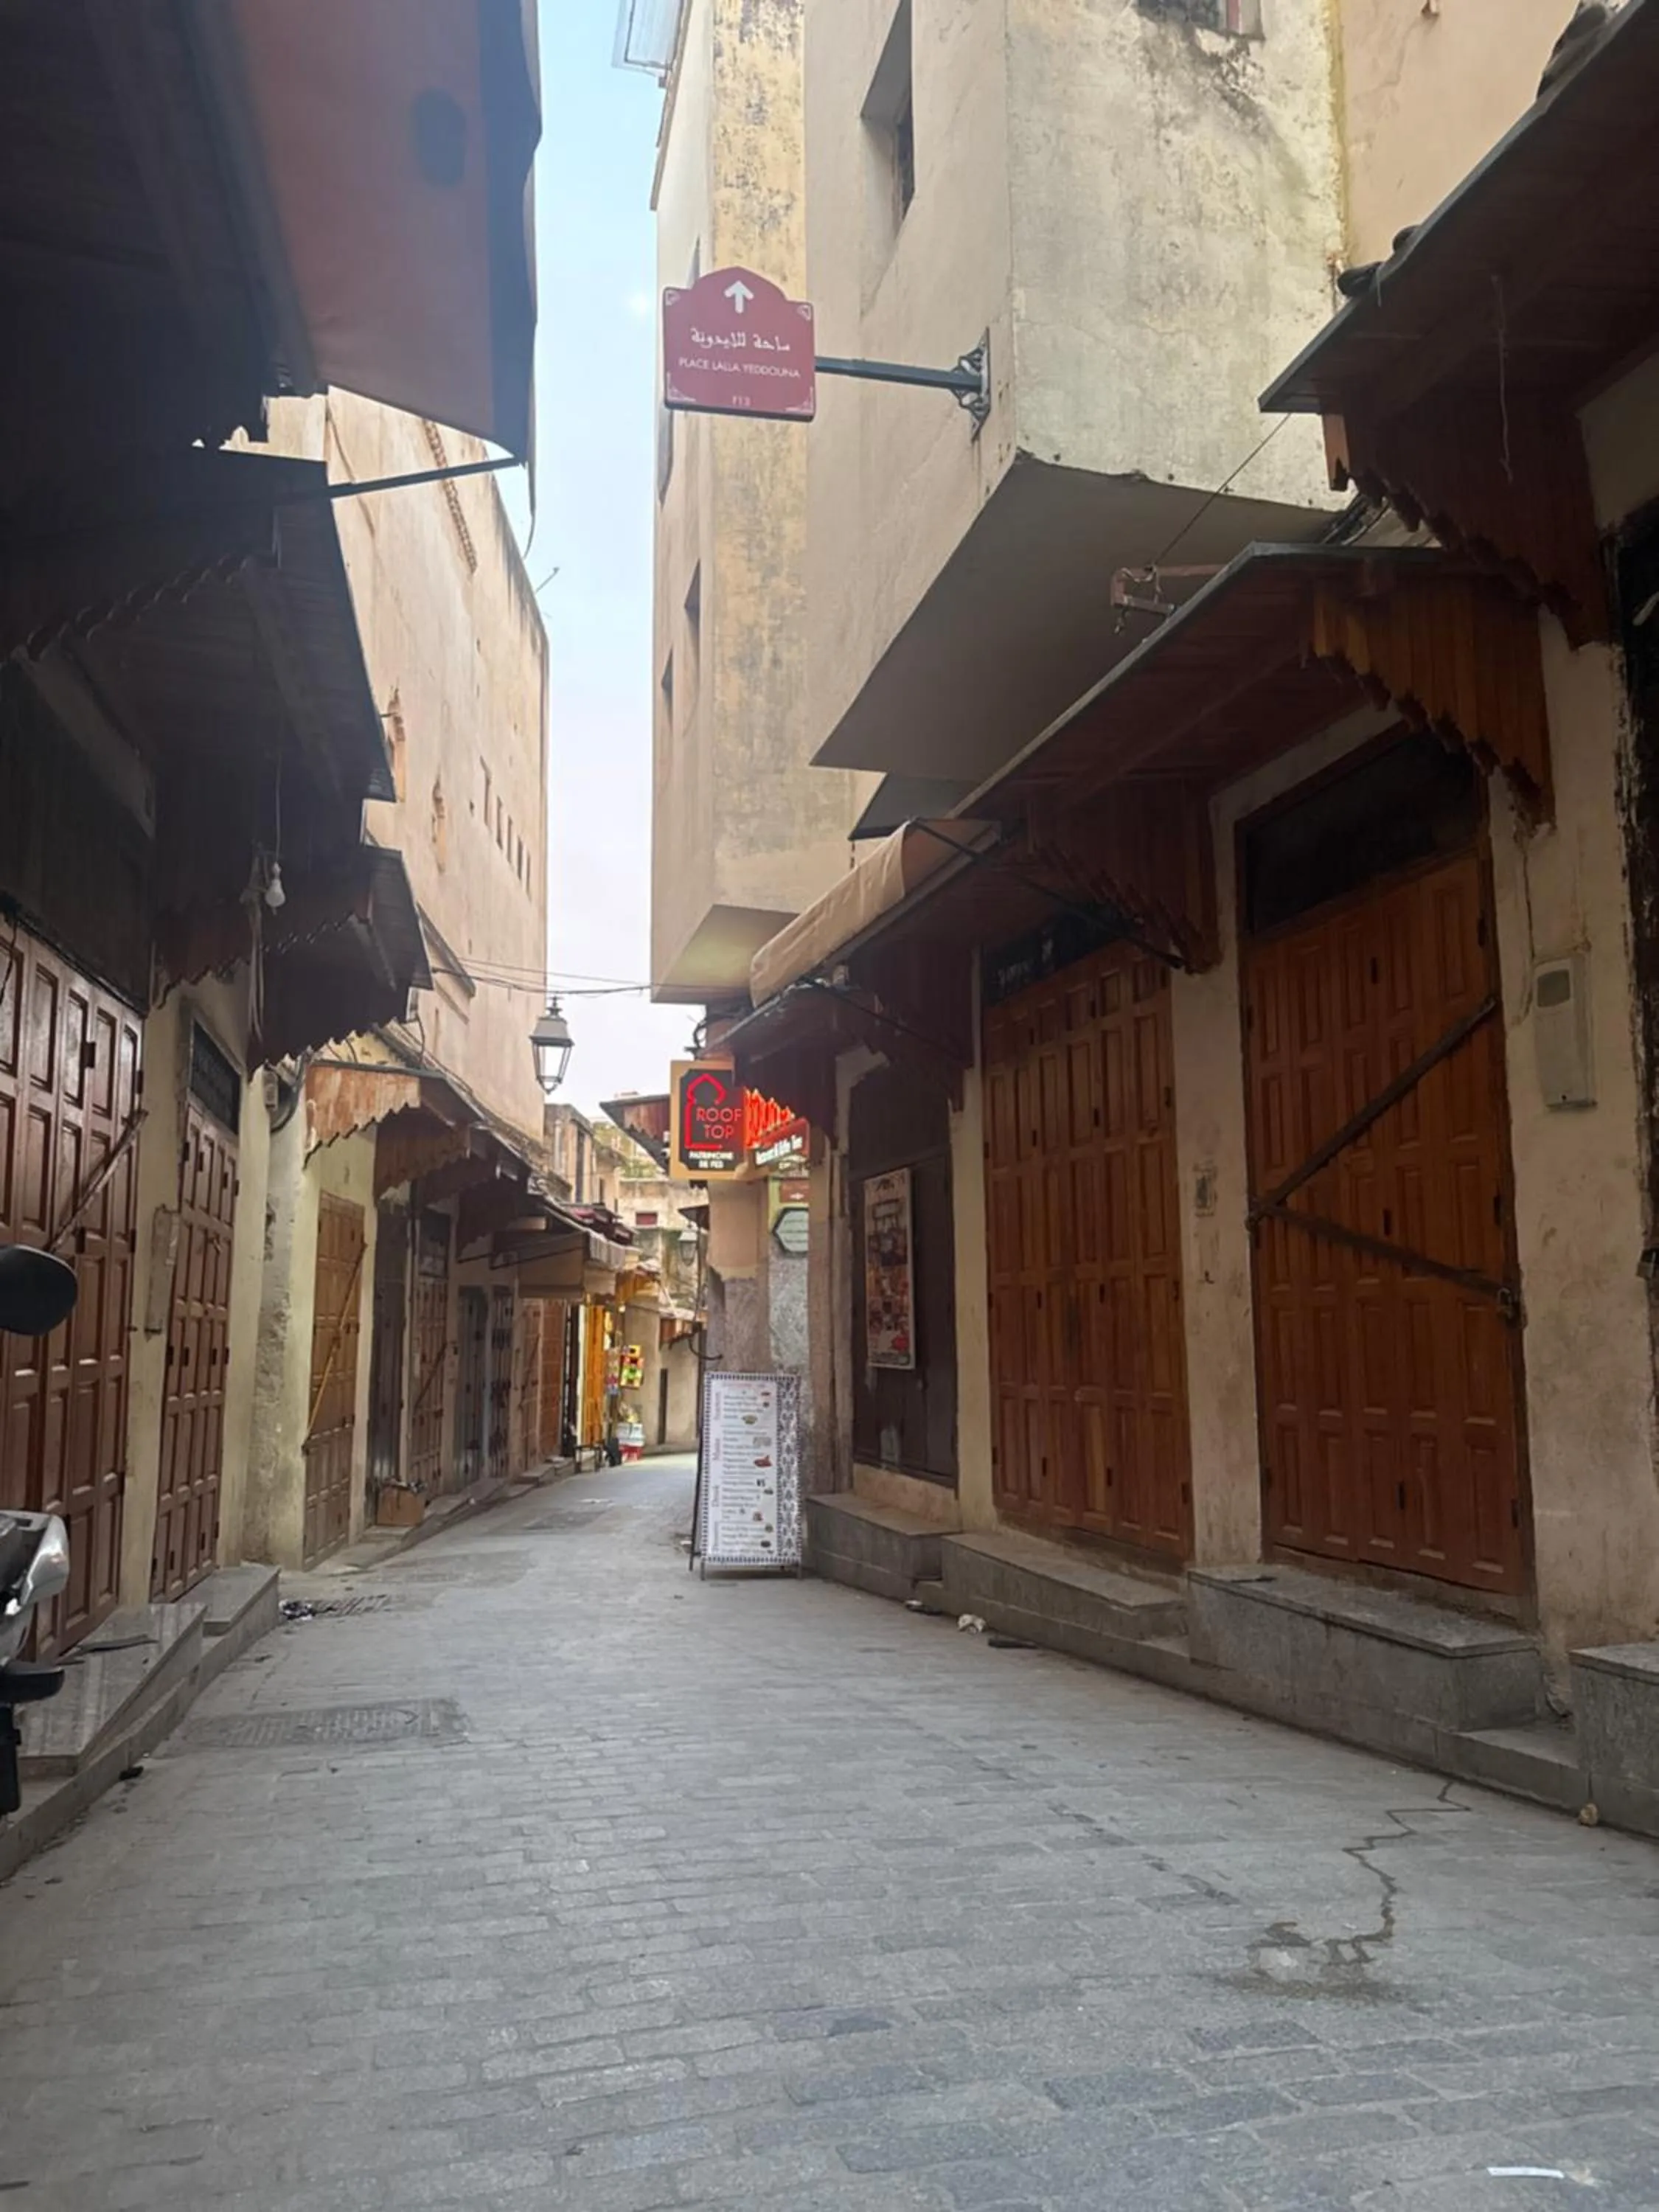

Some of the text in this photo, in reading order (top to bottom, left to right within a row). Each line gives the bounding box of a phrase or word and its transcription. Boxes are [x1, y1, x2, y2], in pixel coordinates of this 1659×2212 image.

[679, 357, 709, 369] PLACE
[712, 359, 740, 372] LALLA
[696, 1107, 742, 1122] ROOF
[703, 1124, 734, 1139] TOP
